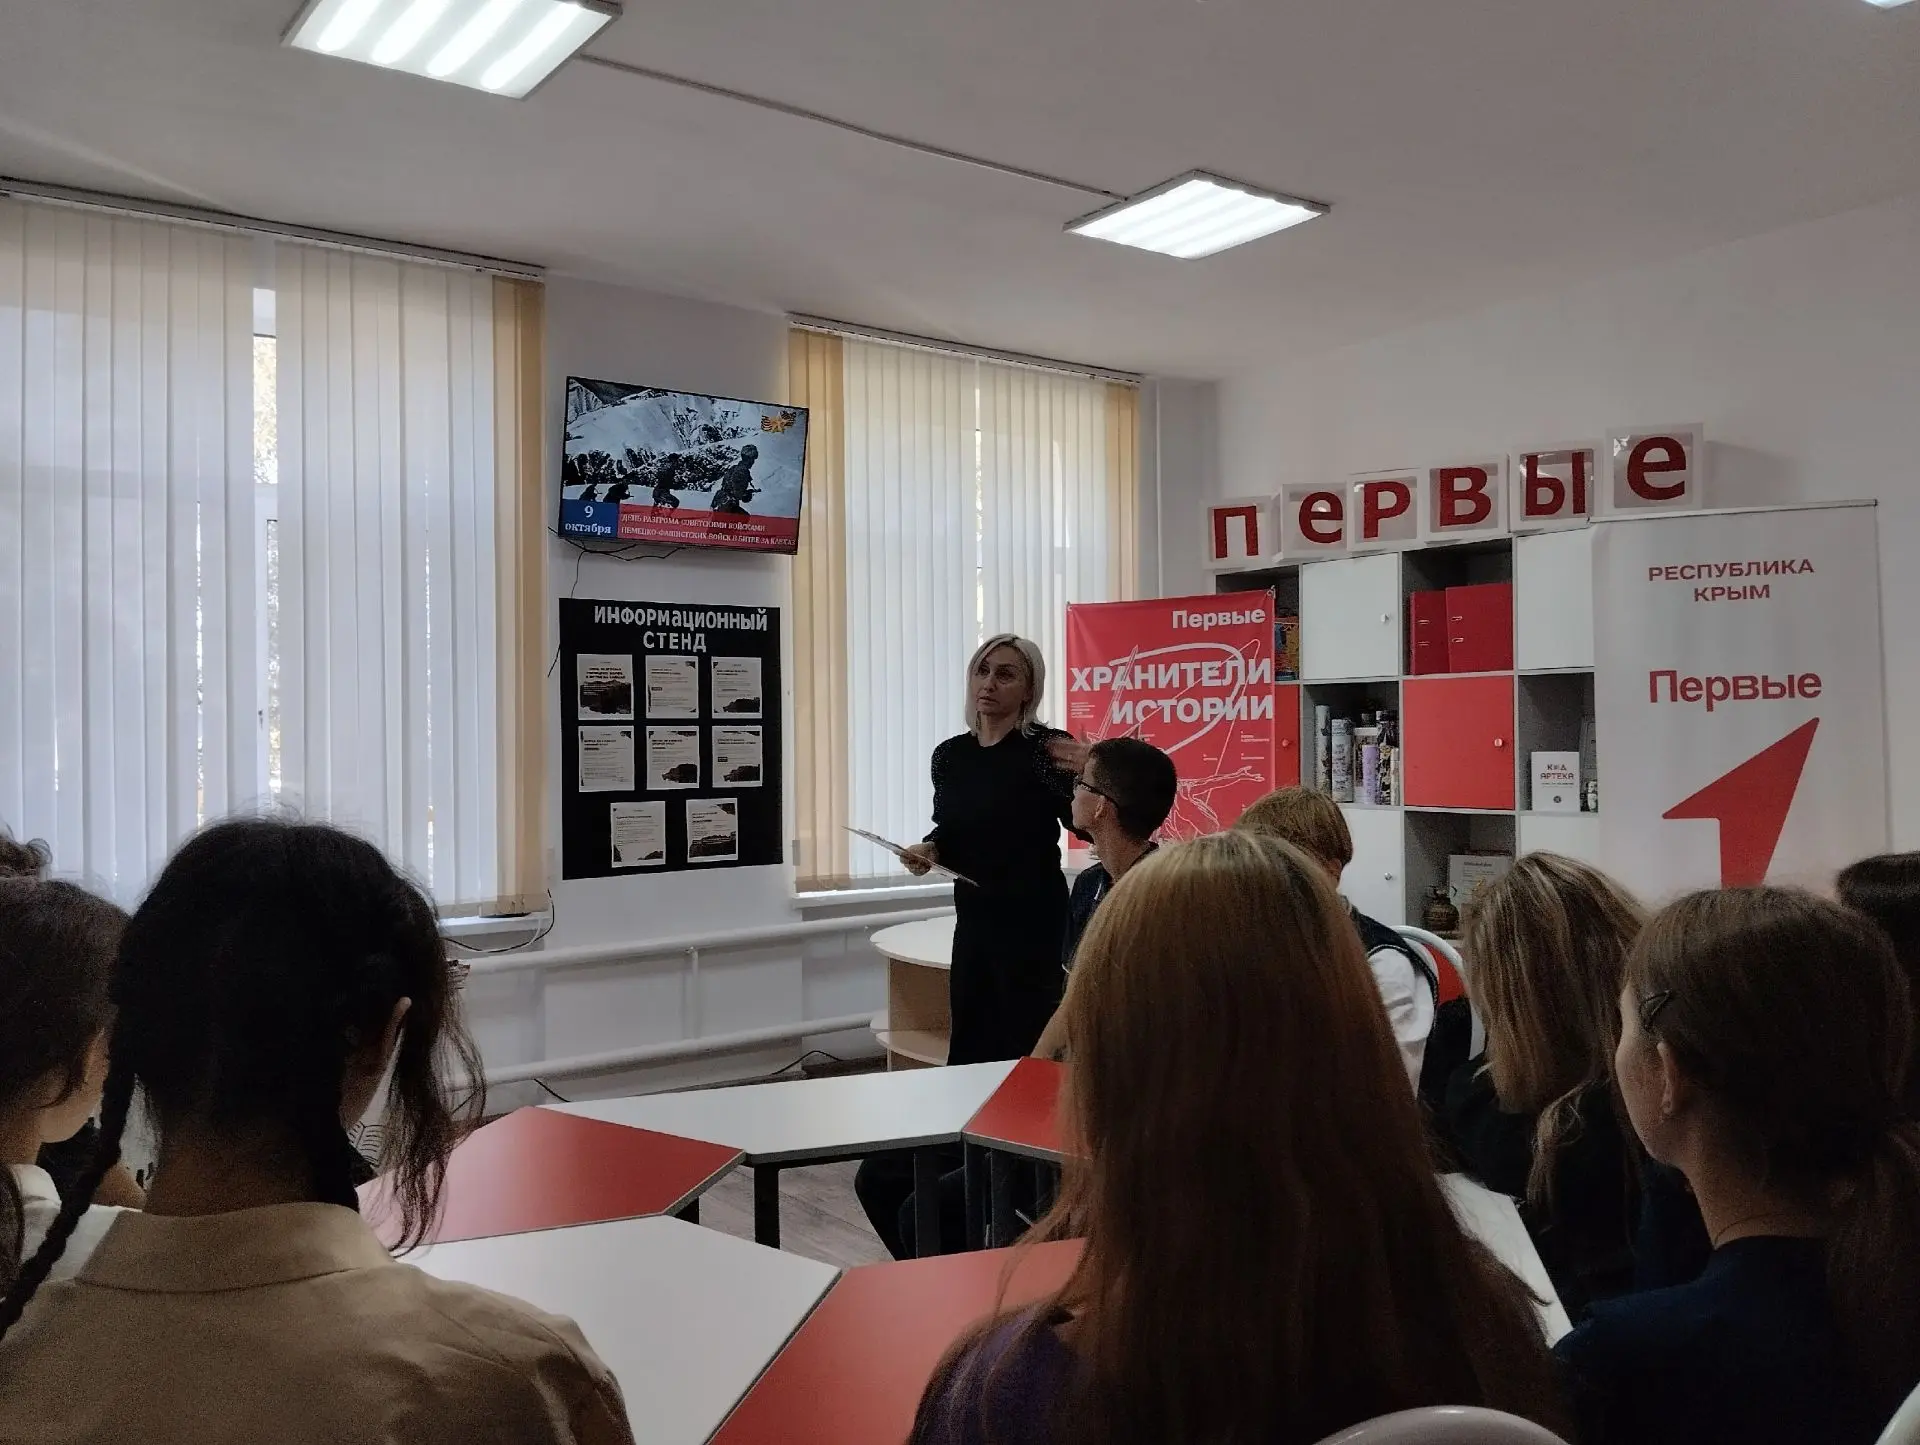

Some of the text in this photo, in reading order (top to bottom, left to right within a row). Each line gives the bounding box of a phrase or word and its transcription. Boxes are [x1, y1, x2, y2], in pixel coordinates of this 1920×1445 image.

[584, 505, 594, 518] 9
[565, 521, 612, 535] октября
[621, 514, 766, 532] ДЕНЬ РАЗГРОМА СОВЕТСКИМИ ВОЙСКАМИ
[708, 532, 731, 541] ВОЙСК
[1648, 558, 1815, 582] РЕСПУБЛИКА
[1693, 584, 1771, 603] КРЫМ
[1172, 608, 1266, 631] Первые
[643, 631, 707, 653] СТЕНД
[1070, 657, 1272, 692] ХРАНИТЕЛИ
[1649, 670, 1822, 712] Первые
[1110, 694, 1273, 725] ИСТОРИИ
